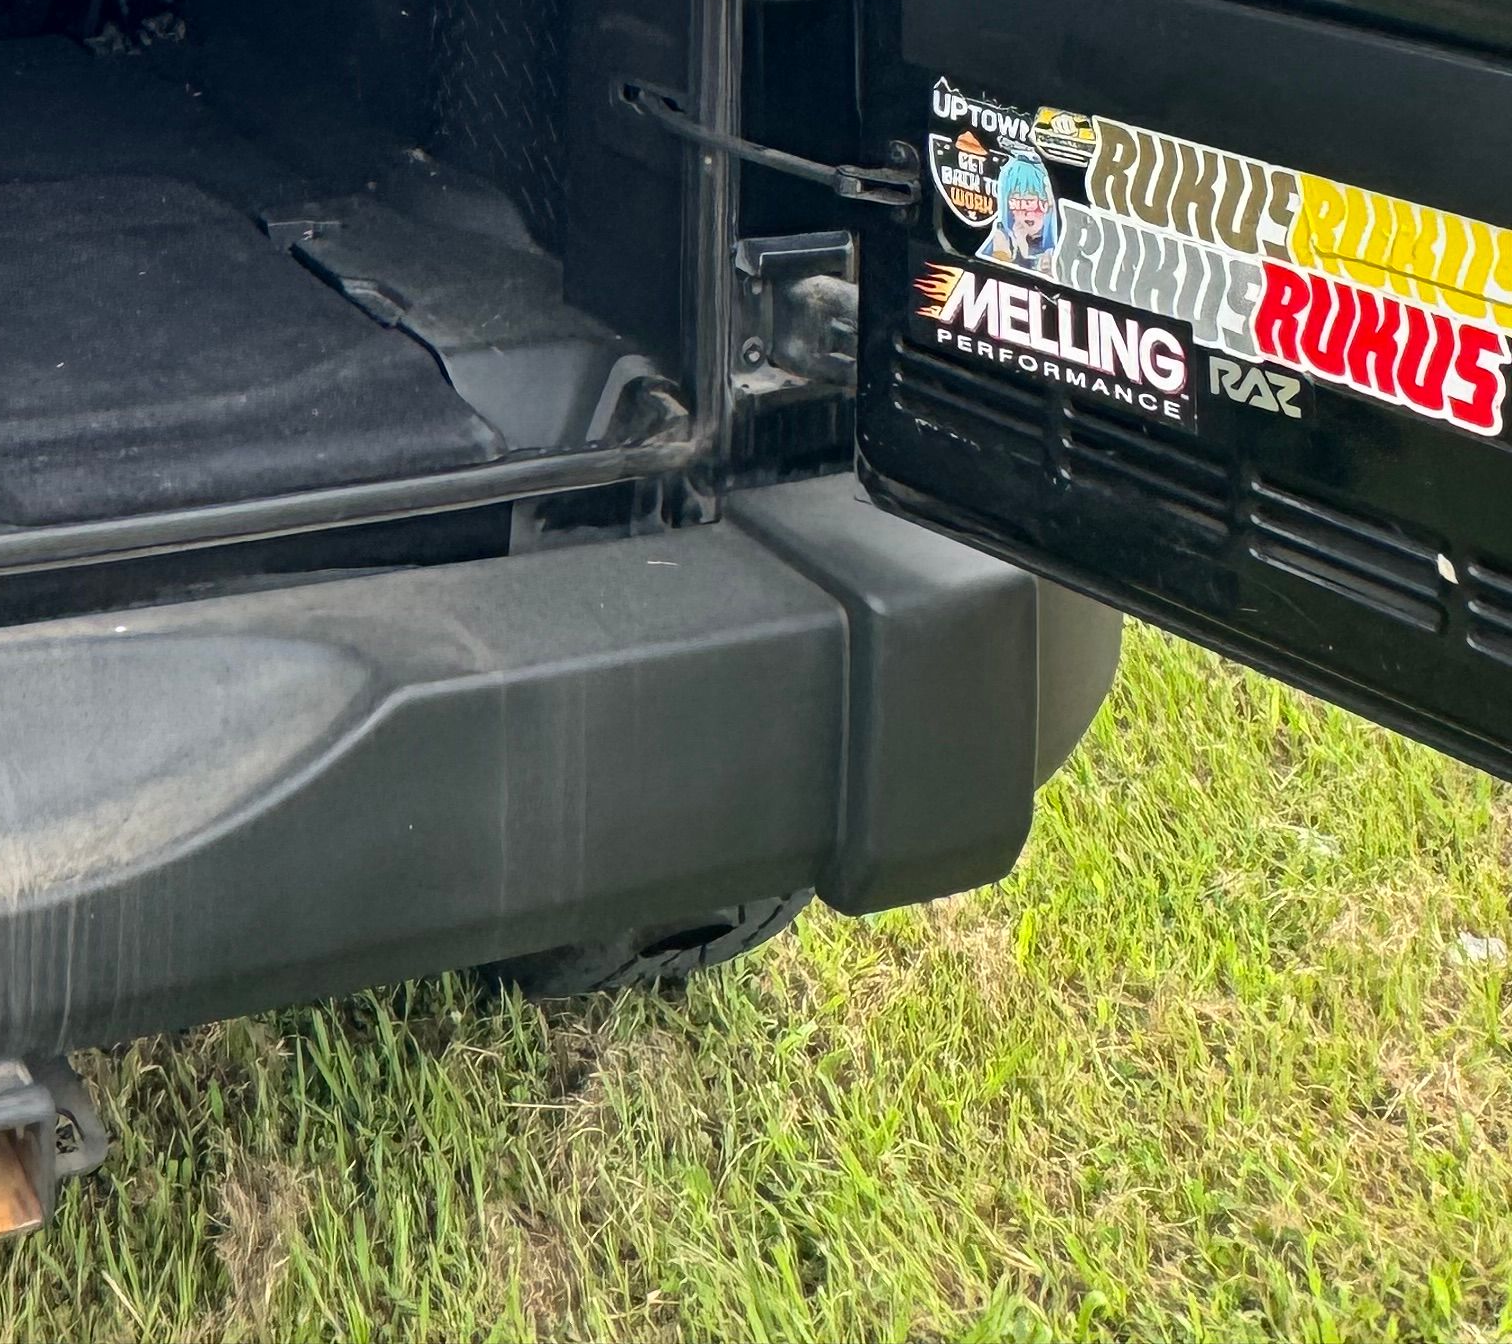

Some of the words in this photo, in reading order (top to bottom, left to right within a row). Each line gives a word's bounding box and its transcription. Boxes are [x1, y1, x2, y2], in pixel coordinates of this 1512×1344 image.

[941, 166, 981, 193] BACK
[958, 152, 986, 175] GET
[1091, 120, 1299, 262] RUKUS
[939, 271, 1187, 394] MELLING
[1056, 205, 1262, 356] RUKUS
[936, 328, 1182, 420] PERFORMANCE
[1254, 261, 1504, 429] RUKUS
